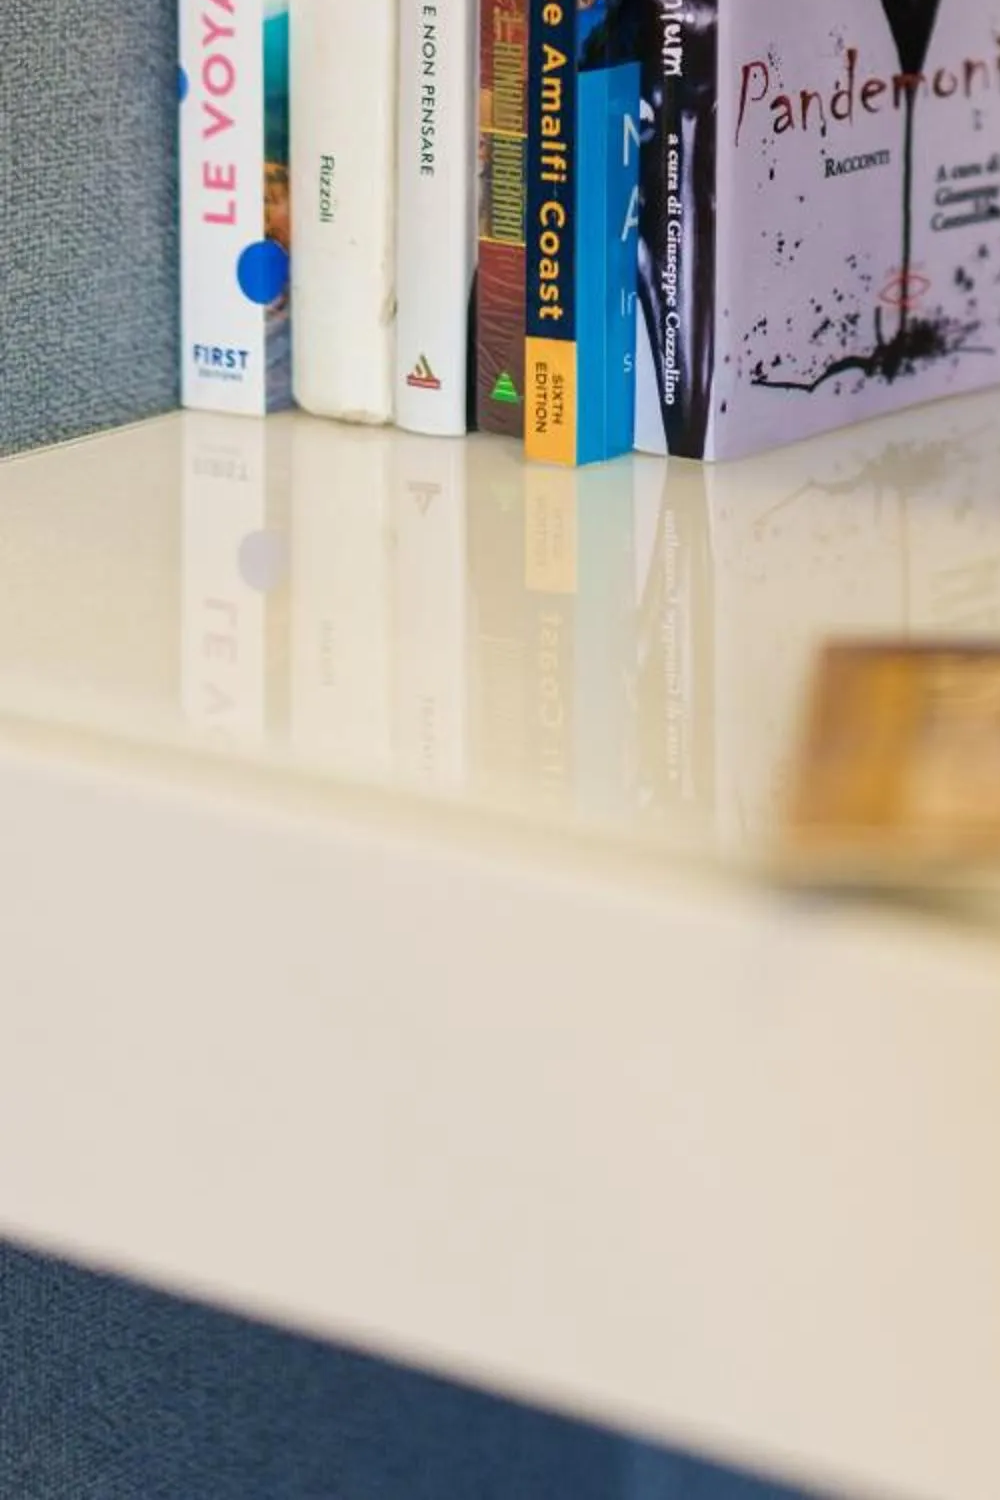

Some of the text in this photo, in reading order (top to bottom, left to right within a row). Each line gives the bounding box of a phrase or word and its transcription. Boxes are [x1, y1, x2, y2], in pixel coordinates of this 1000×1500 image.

[423, 5, 437, 16] E
[421, 25, 436, 77] NON
[419, 85, 436, 177] PENSARE
[540, 44, 568, 183] Amalfi
[203, 160, 236, 227] LE
[320, 155, 335, 224] Rizzoli
[539, 201, 566, 321] Coast
[661, 132, 682, 406] a cura di Giuseppe Cozzolino
[193, 344, 249, 369] FIRST
[535, 361, 548, 434] EDITION
[552, 372, 564, 426] SIXTH
